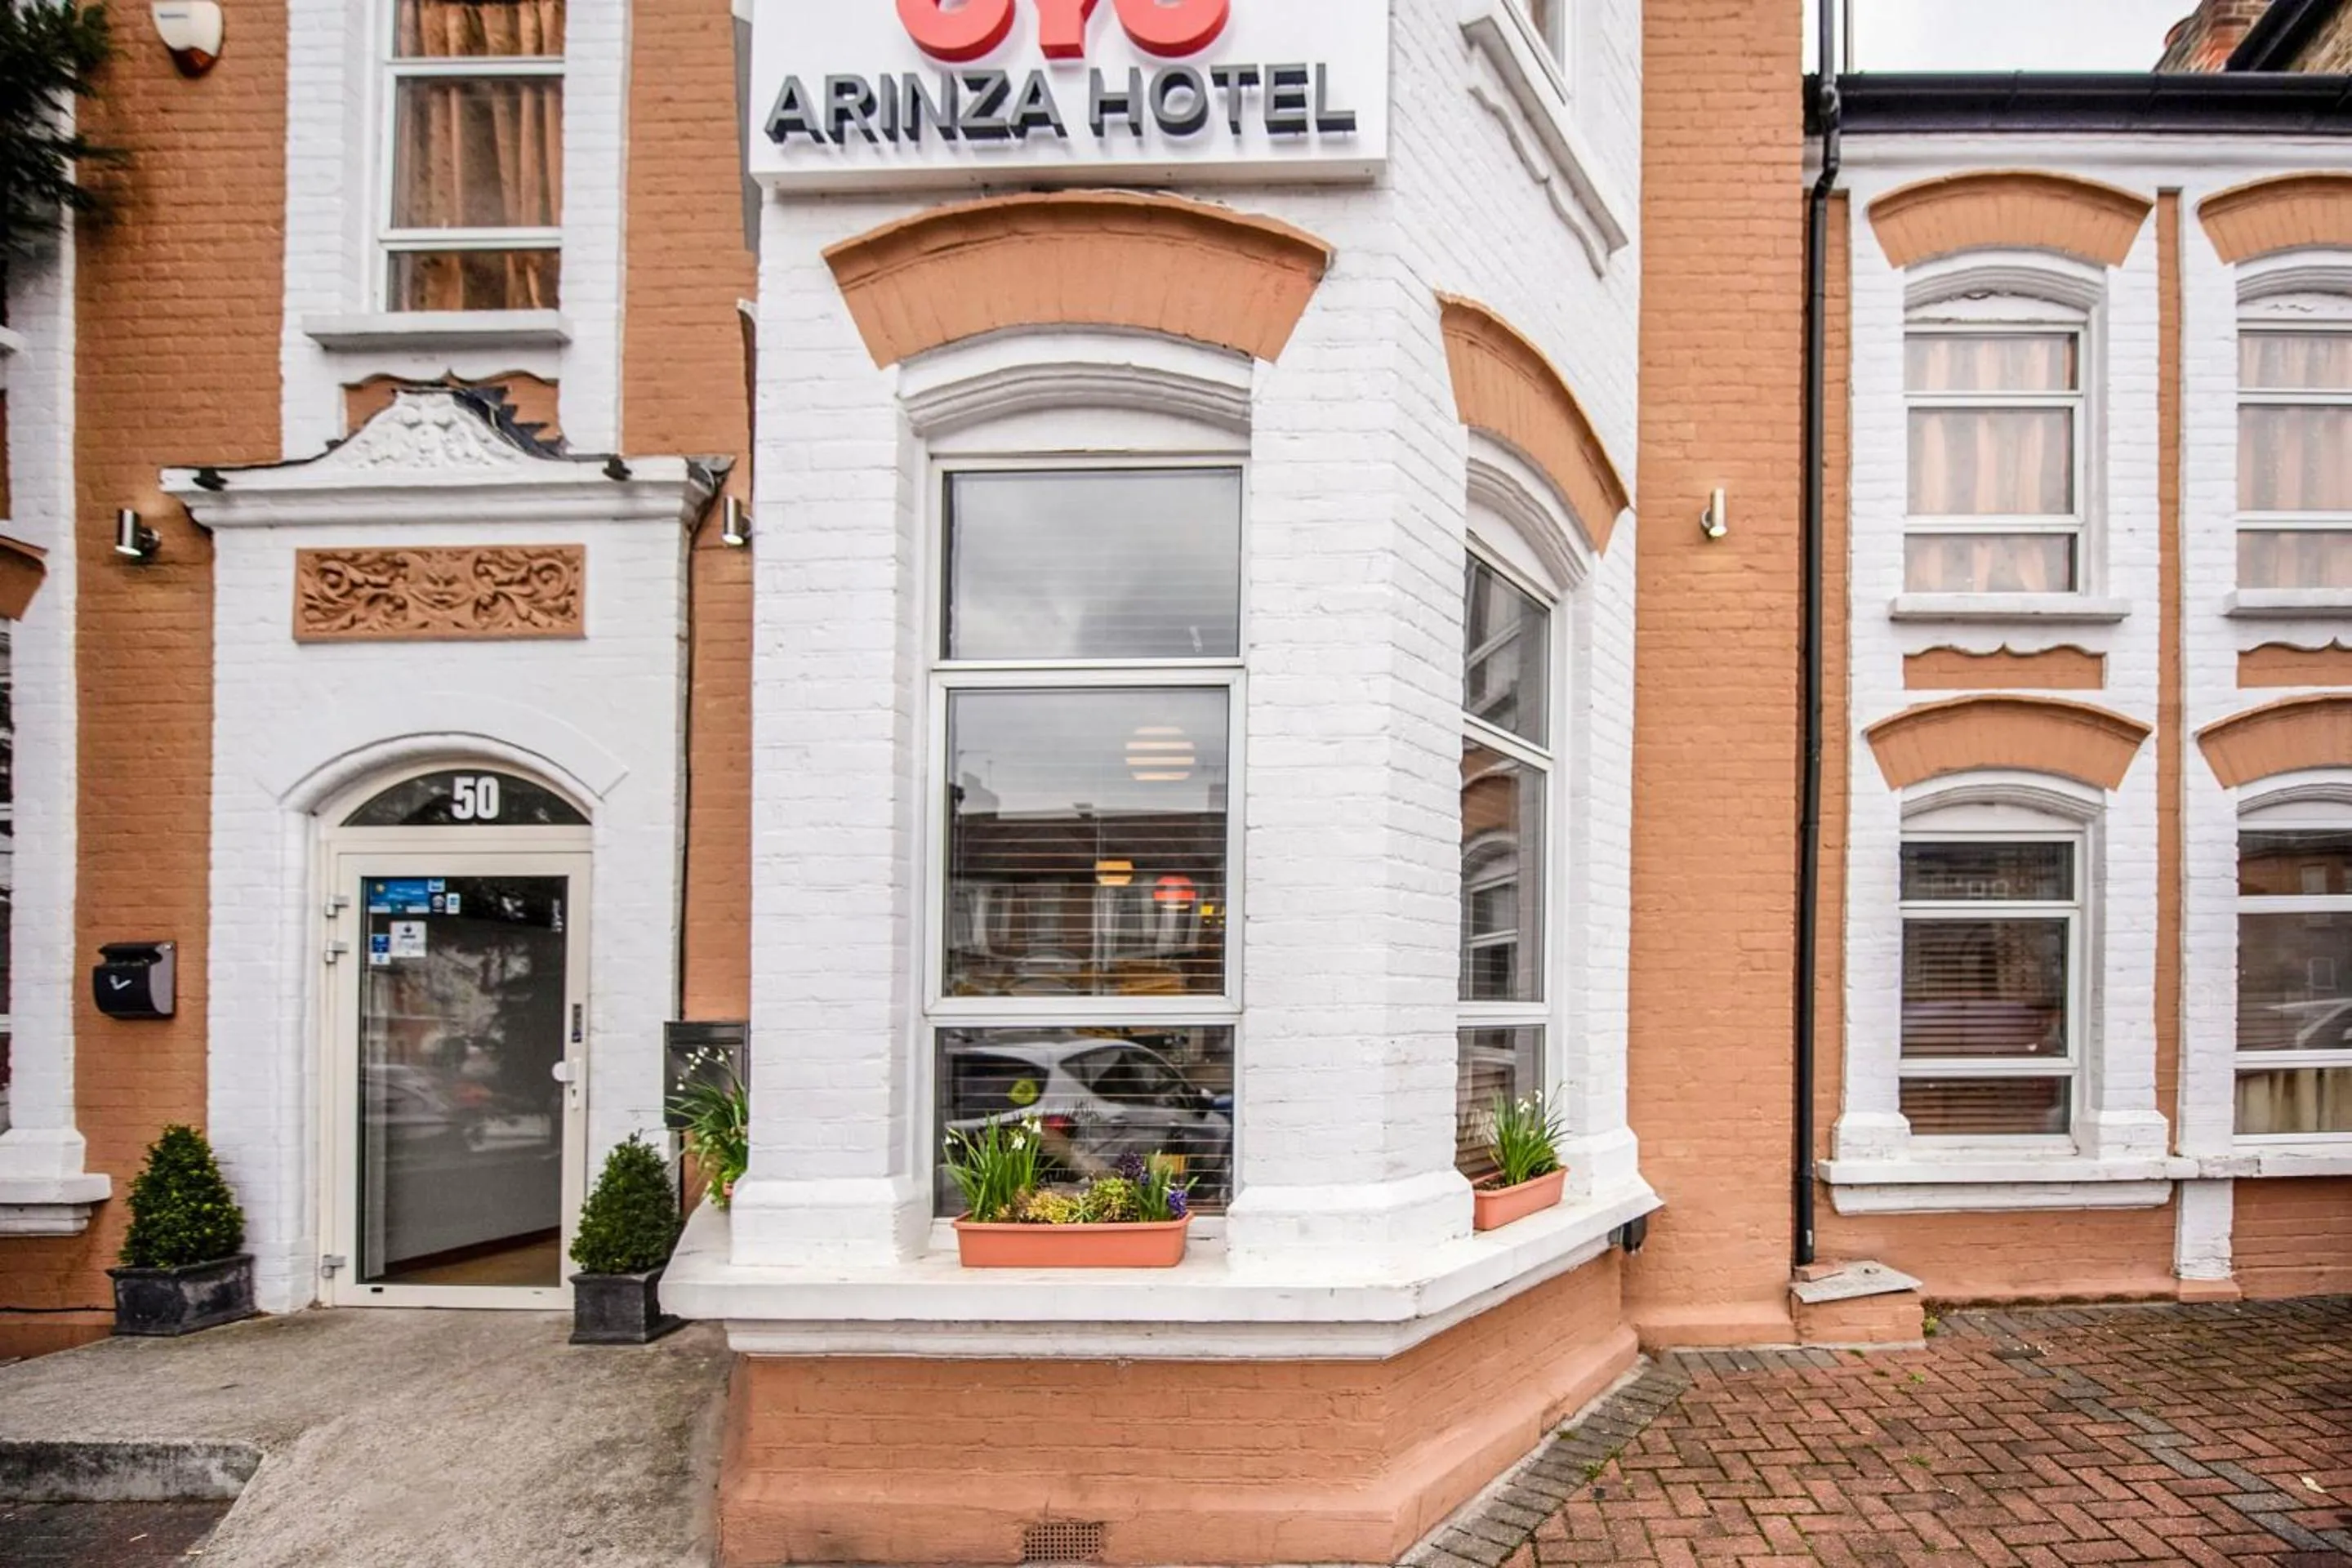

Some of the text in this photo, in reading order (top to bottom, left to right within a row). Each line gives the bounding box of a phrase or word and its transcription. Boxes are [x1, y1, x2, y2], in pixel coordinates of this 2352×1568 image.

[764, 63, 1356, 144] ARINZA HOTEL
[452, 777, 499, 819] 50
